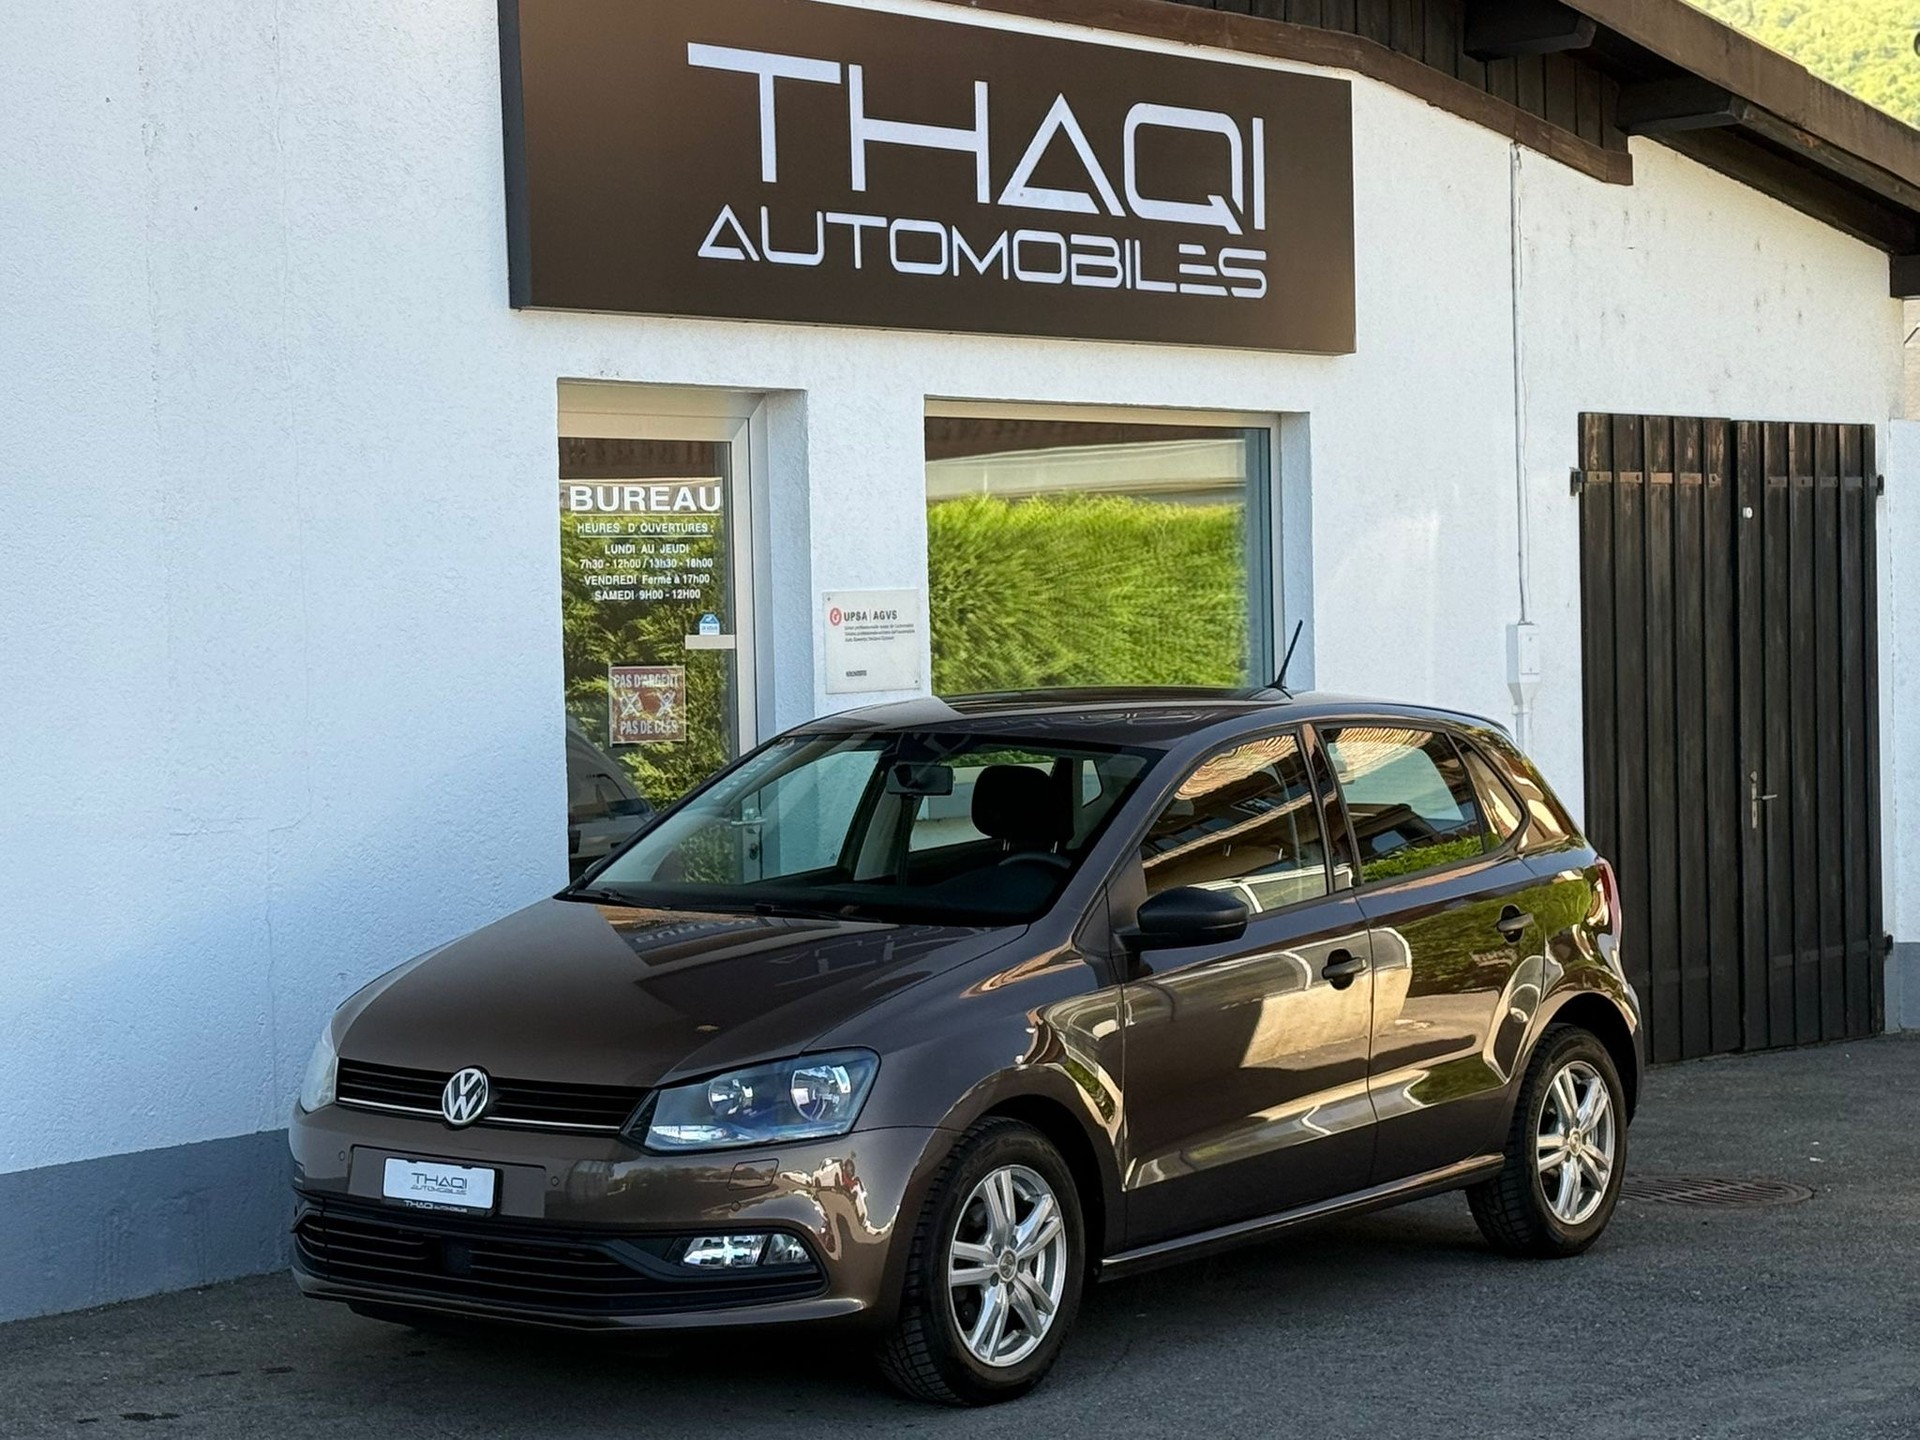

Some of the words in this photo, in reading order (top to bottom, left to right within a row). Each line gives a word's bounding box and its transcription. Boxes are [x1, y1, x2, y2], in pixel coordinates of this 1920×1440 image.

[687, 41, 1266, 235] THAQI
[697, 203, 1268, 299] AUTOMOBILES
[569, 485, 721, 512] BUREAU
[577, 522, 620, 533] HEURES
[604, 544, 636, 555] LUNDI
[641, 544, 655, 554] AU
[659, 543, 690, 554] JEUDI
[579, 559, 604, 569] 7h30
[613, 558, 642, 569] 12h00
[649, 558, 677, 568] 13h30
[584, 575, 637, 586] VENDREDI
[682, 574, 710, 584] 17h00
[594, 590, 635, 600] SAMEDI
[639, 589, 664, 600] 9H00
[672, 589, 701, 599] 12H00
[844, 611, 868, 621] UPSA
[873, 610, 898, 620] AGVS
[614, 674, 632, 688] PAS
[620, 720, 639, 735] PAS
[640, 720, 653, 735] DE
[411, 1172, 468, 1190] THAQI
